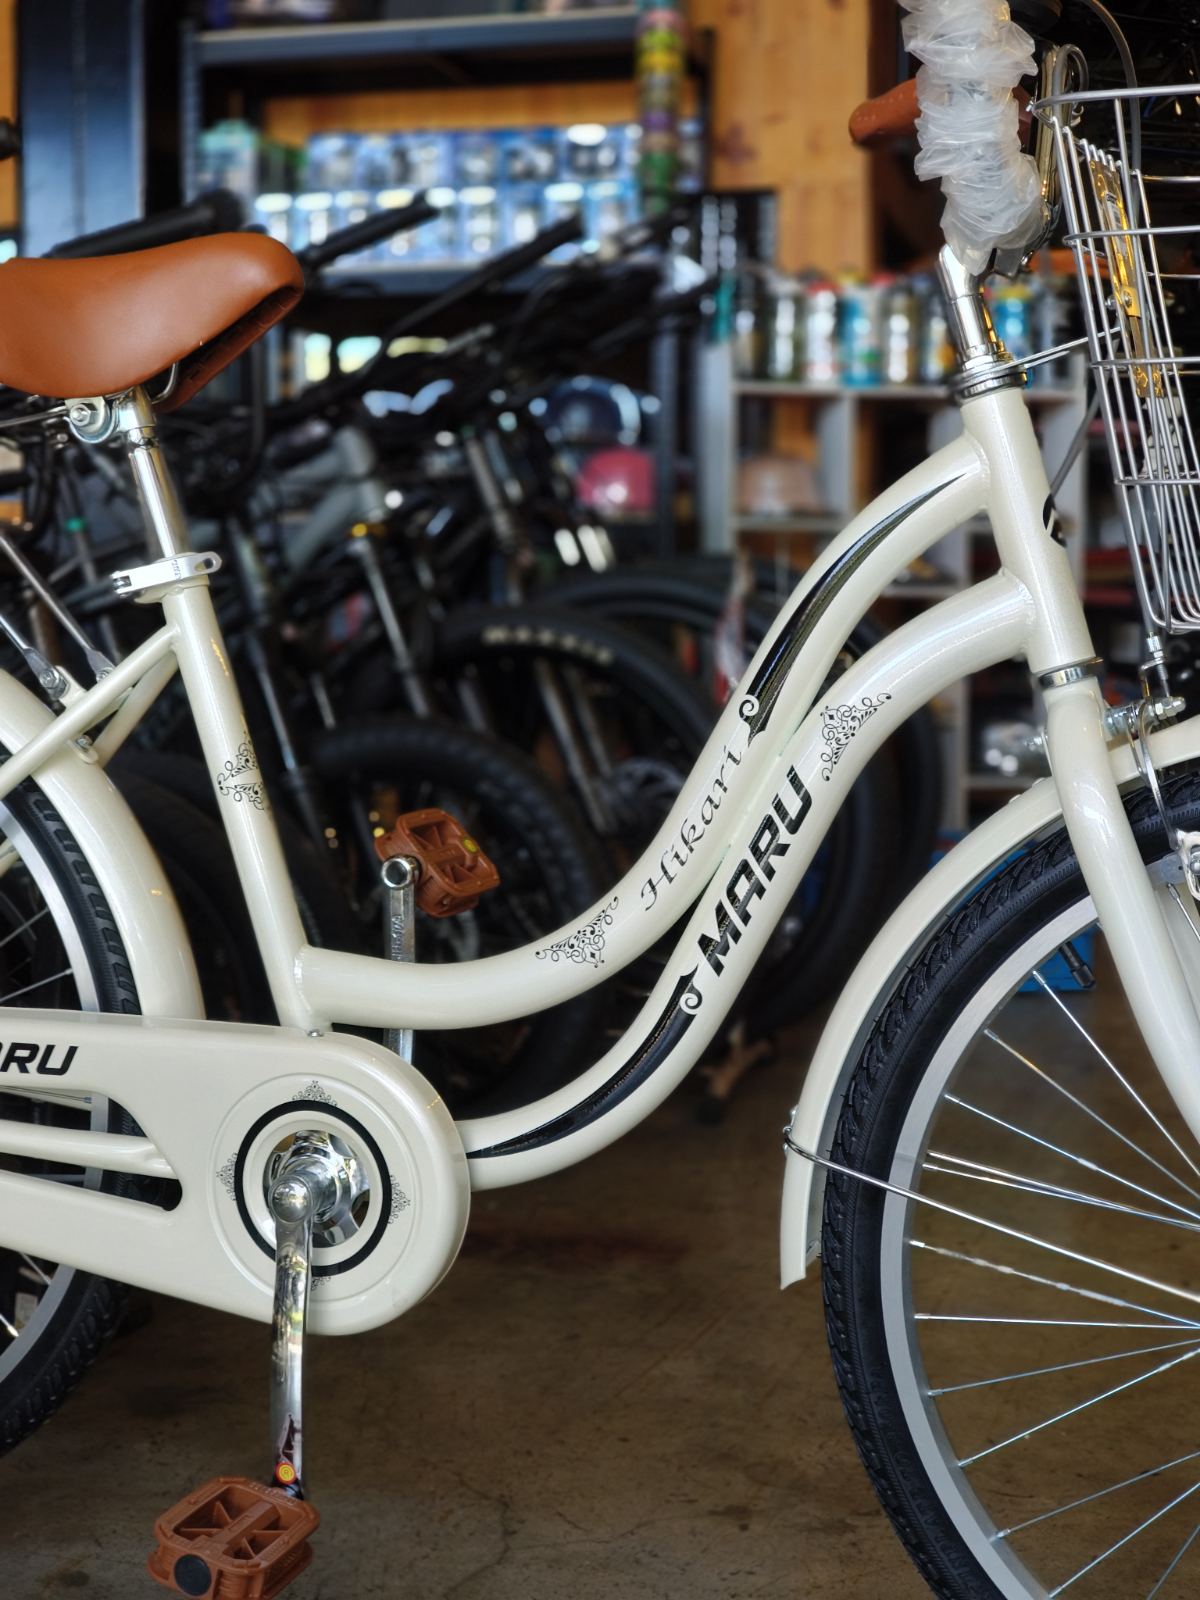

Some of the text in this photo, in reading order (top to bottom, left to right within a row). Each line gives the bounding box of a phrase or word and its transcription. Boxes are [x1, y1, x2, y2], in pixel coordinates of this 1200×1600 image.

[640, 745, 742, 912] Hikari
[697, 764, 813, 977] MARU
[0, 1042, 79, 1076] RU
